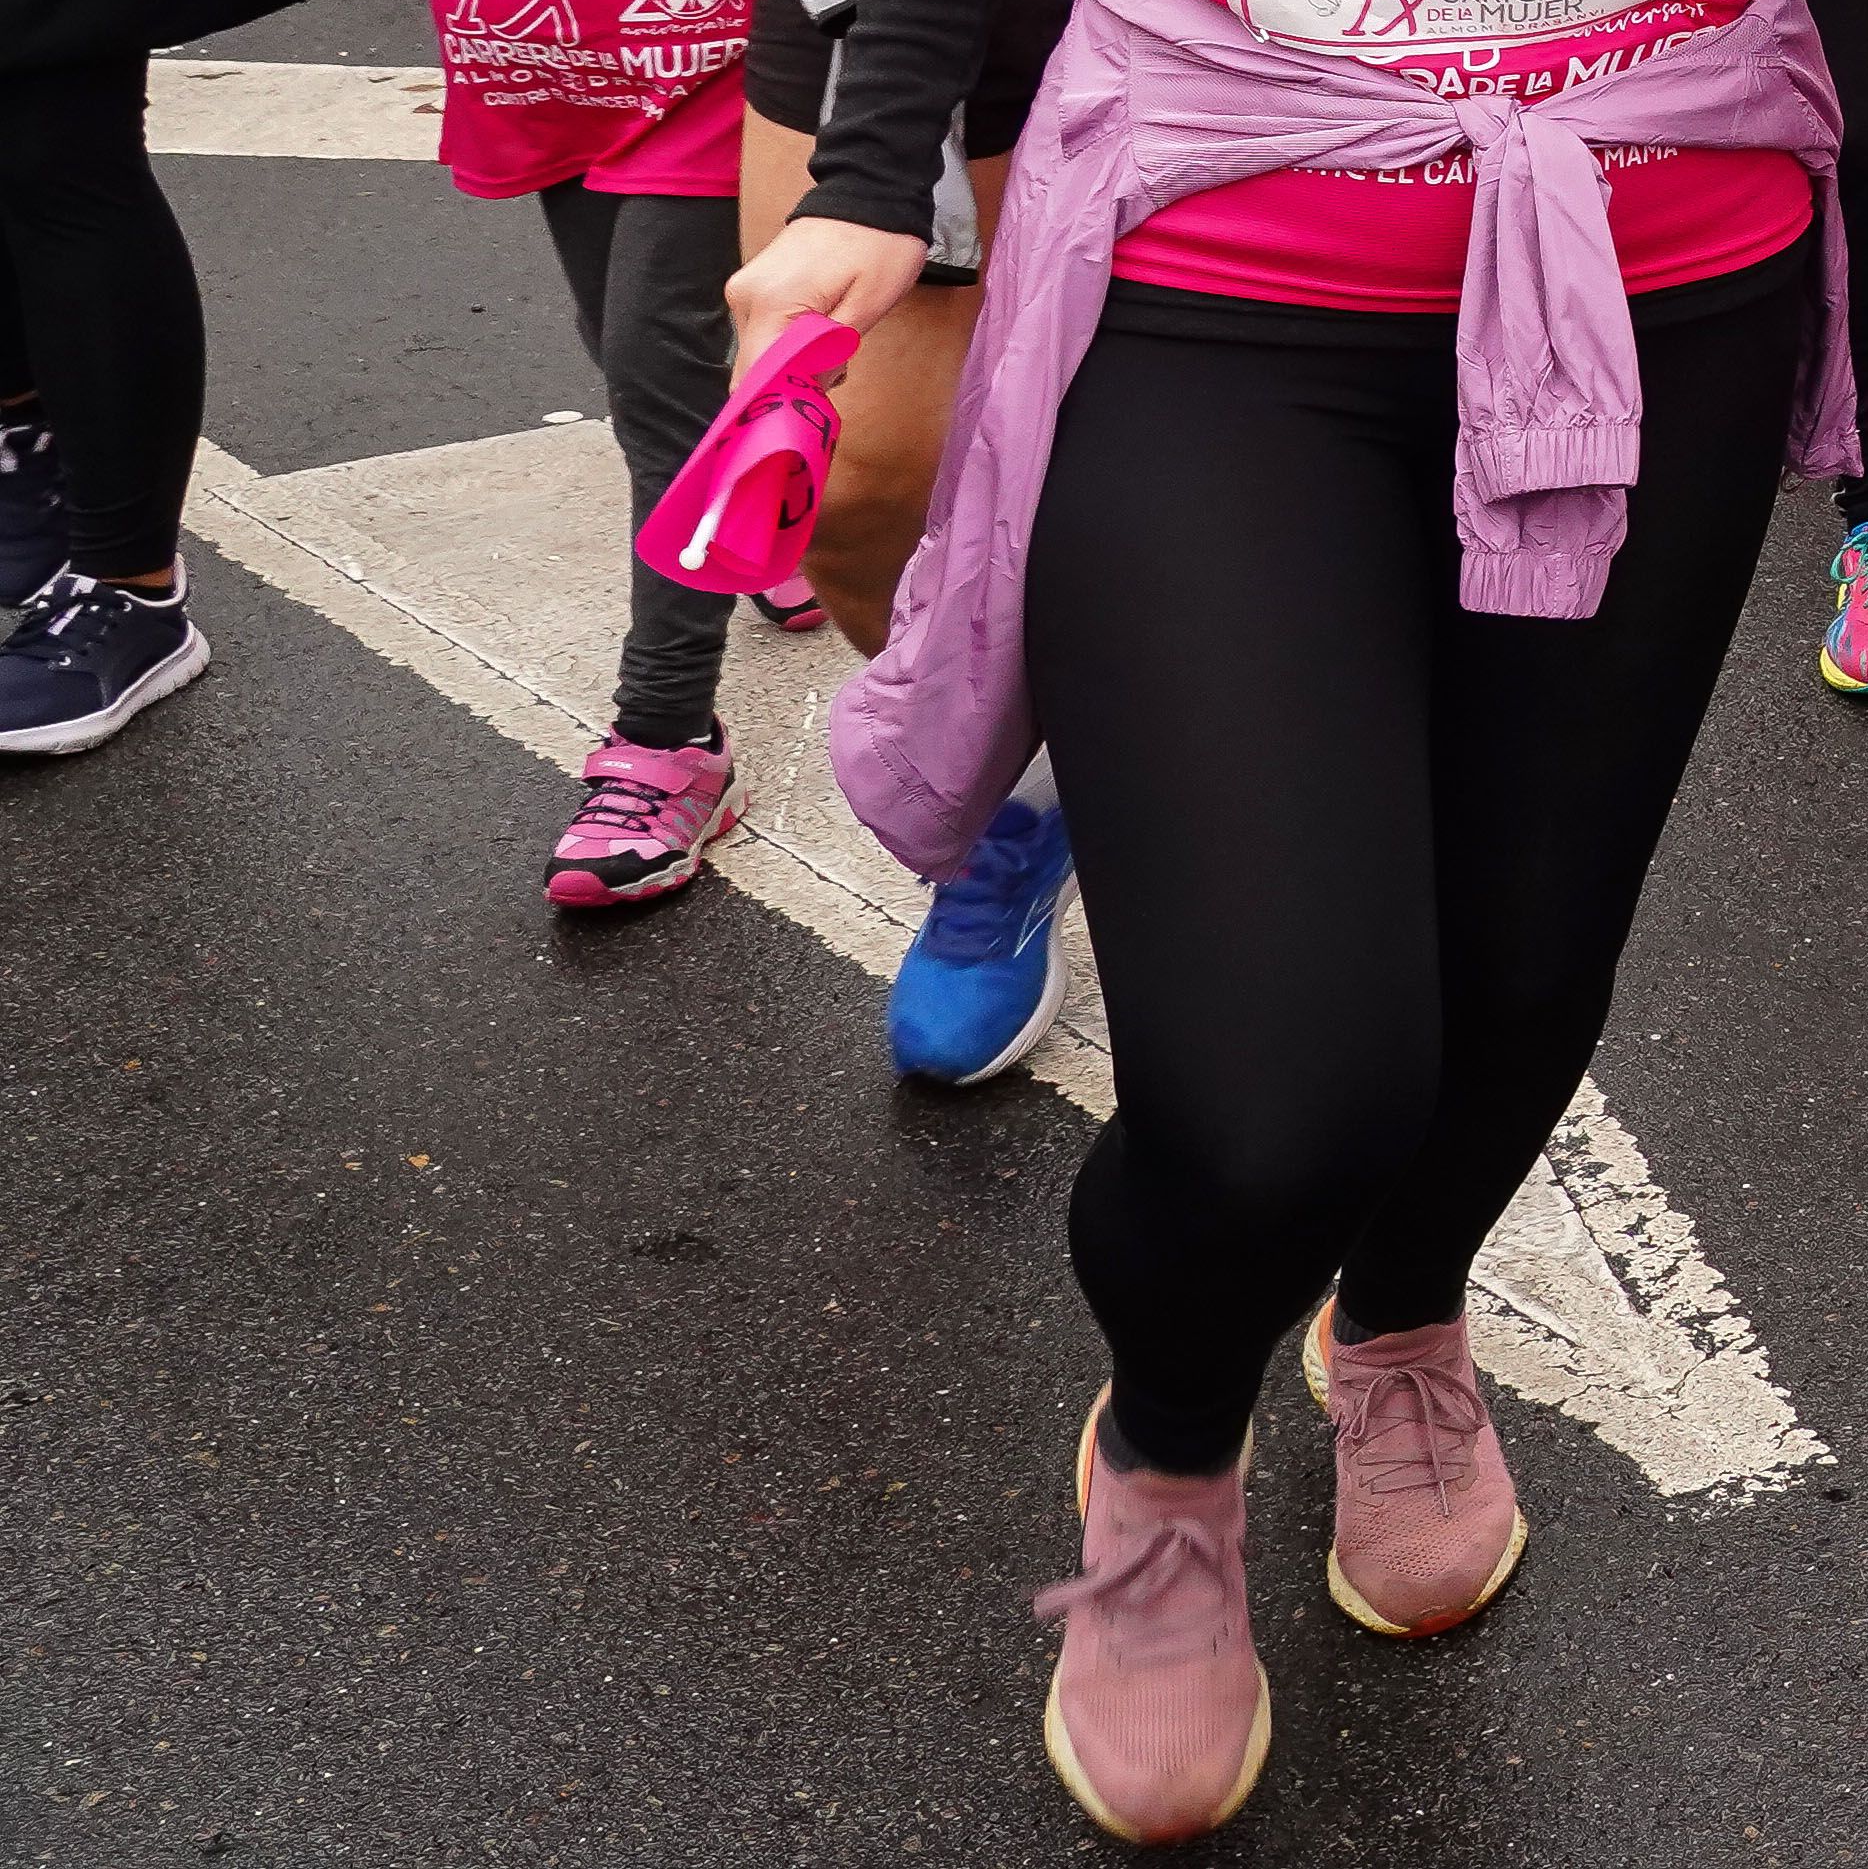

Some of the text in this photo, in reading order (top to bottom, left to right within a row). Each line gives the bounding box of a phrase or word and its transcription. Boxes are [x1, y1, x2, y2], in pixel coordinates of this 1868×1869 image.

[1426, 6, 1456, 23] DE
[443, 33, 573, 71] CARRERA
[619, 38, 750, 79] MUJER
[1469, 78, 1520, 97] DE
[1525, 71, 1554, 98] LA
[1603, 143, 1679, 172] MAMA
